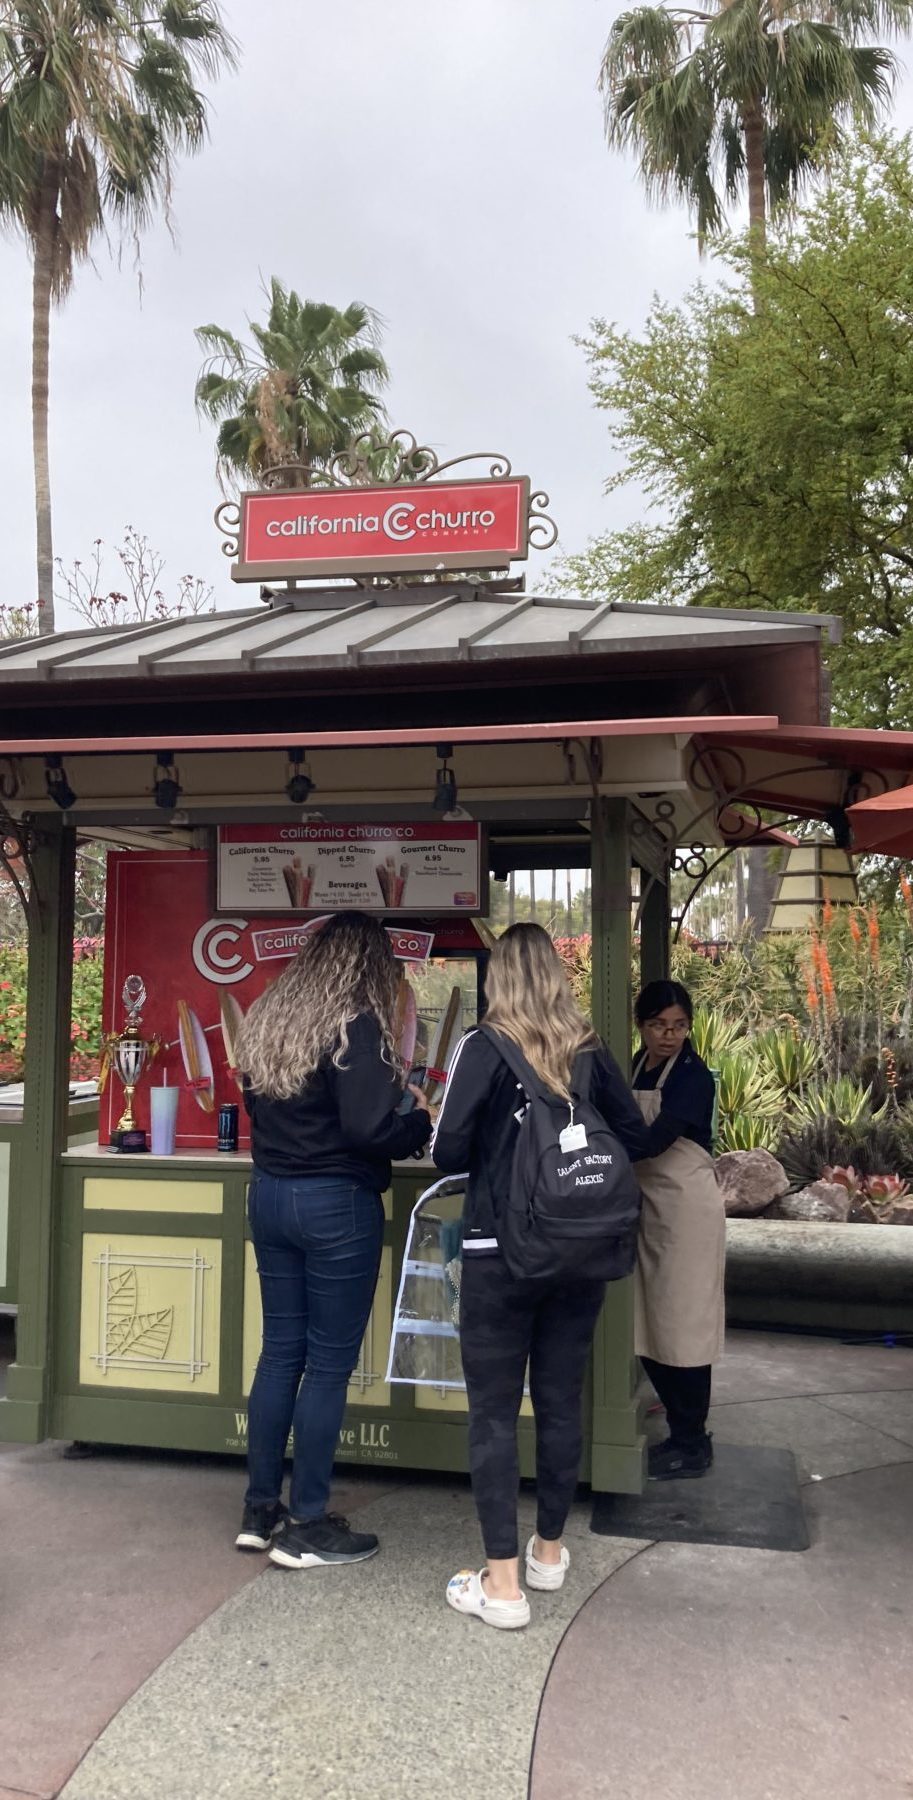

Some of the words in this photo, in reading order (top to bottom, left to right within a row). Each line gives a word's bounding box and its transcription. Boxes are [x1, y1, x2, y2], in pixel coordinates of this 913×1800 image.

[266, 512, 379, 537] california
[415, 508, 496, 531] churro
[422, 528, 490, 538] COMPANY
[279, 827, 344, 839] california
[347, 826, 392, 838] churro
[229, 846, 266, 856] California
[268, 846, 295, 855] Churro
[318, 845, 346, 856] Dipped
[348, 845, 376, 855] Churro
[401, 845, 436, 854] Gourmet
[437, 844, 466, 853] Churro
[328, 880, 368, 889] Beverages
[264, 933, 310, 951] califo
[397, 938, 420, 951] co.
[557, 1159, 582, 1177] TALENT
[584, 1154, 613, 1165] FACTORY
[575, 1173, 604, 1186] ALEXIS
[359, 1422, 390, 1448] LLC
